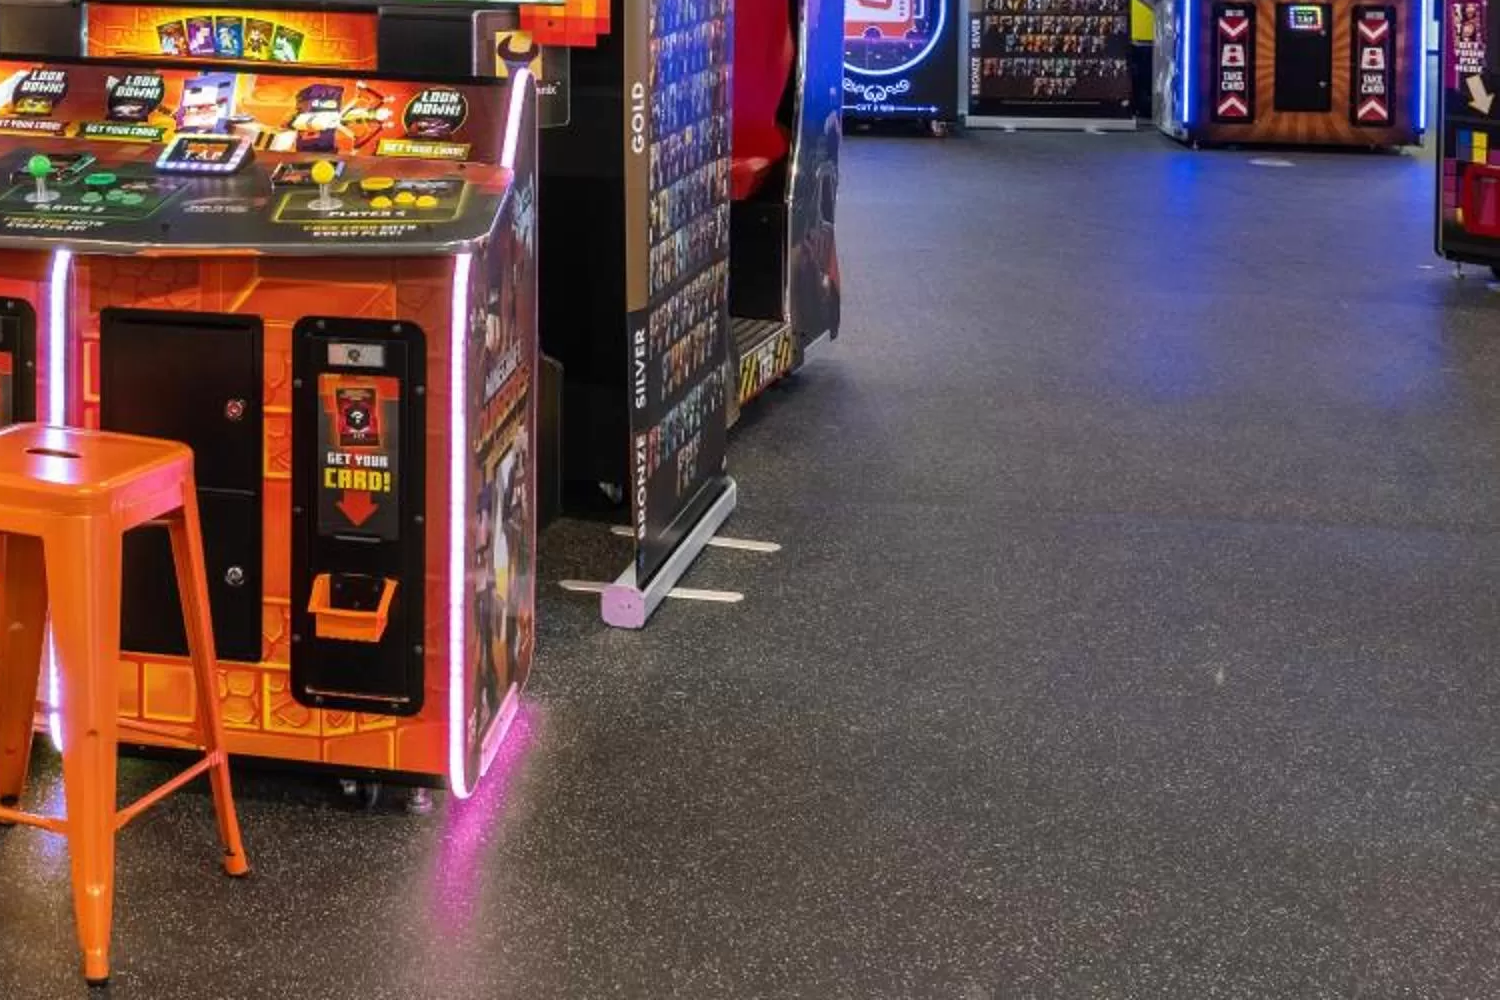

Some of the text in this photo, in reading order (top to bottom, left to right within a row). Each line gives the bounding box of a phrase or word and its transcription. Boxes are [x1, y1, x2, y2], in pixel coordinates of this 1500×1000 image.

[30, 70, 65, 81] LOOK
[124, 74, 159, 86] LOOK
[21, 81, 65, 93] DOWN!
[115, 86, 160, 98] DOWN!
[1221, 81, 1245, 91] CARD
[1361, 84, 1385, 94] CARD
[421, 91, 460, 102] LOOK
[412, 102, 462, 116] DOWN!
[631, 82, 645, 154] GOLD
[633, 327, 646, 409] SILVER
[327, 451, 389, 468] GET YOUR
[323, 467, 392, 493] CARD!
[635, 432, 647, 540] BRONZE
